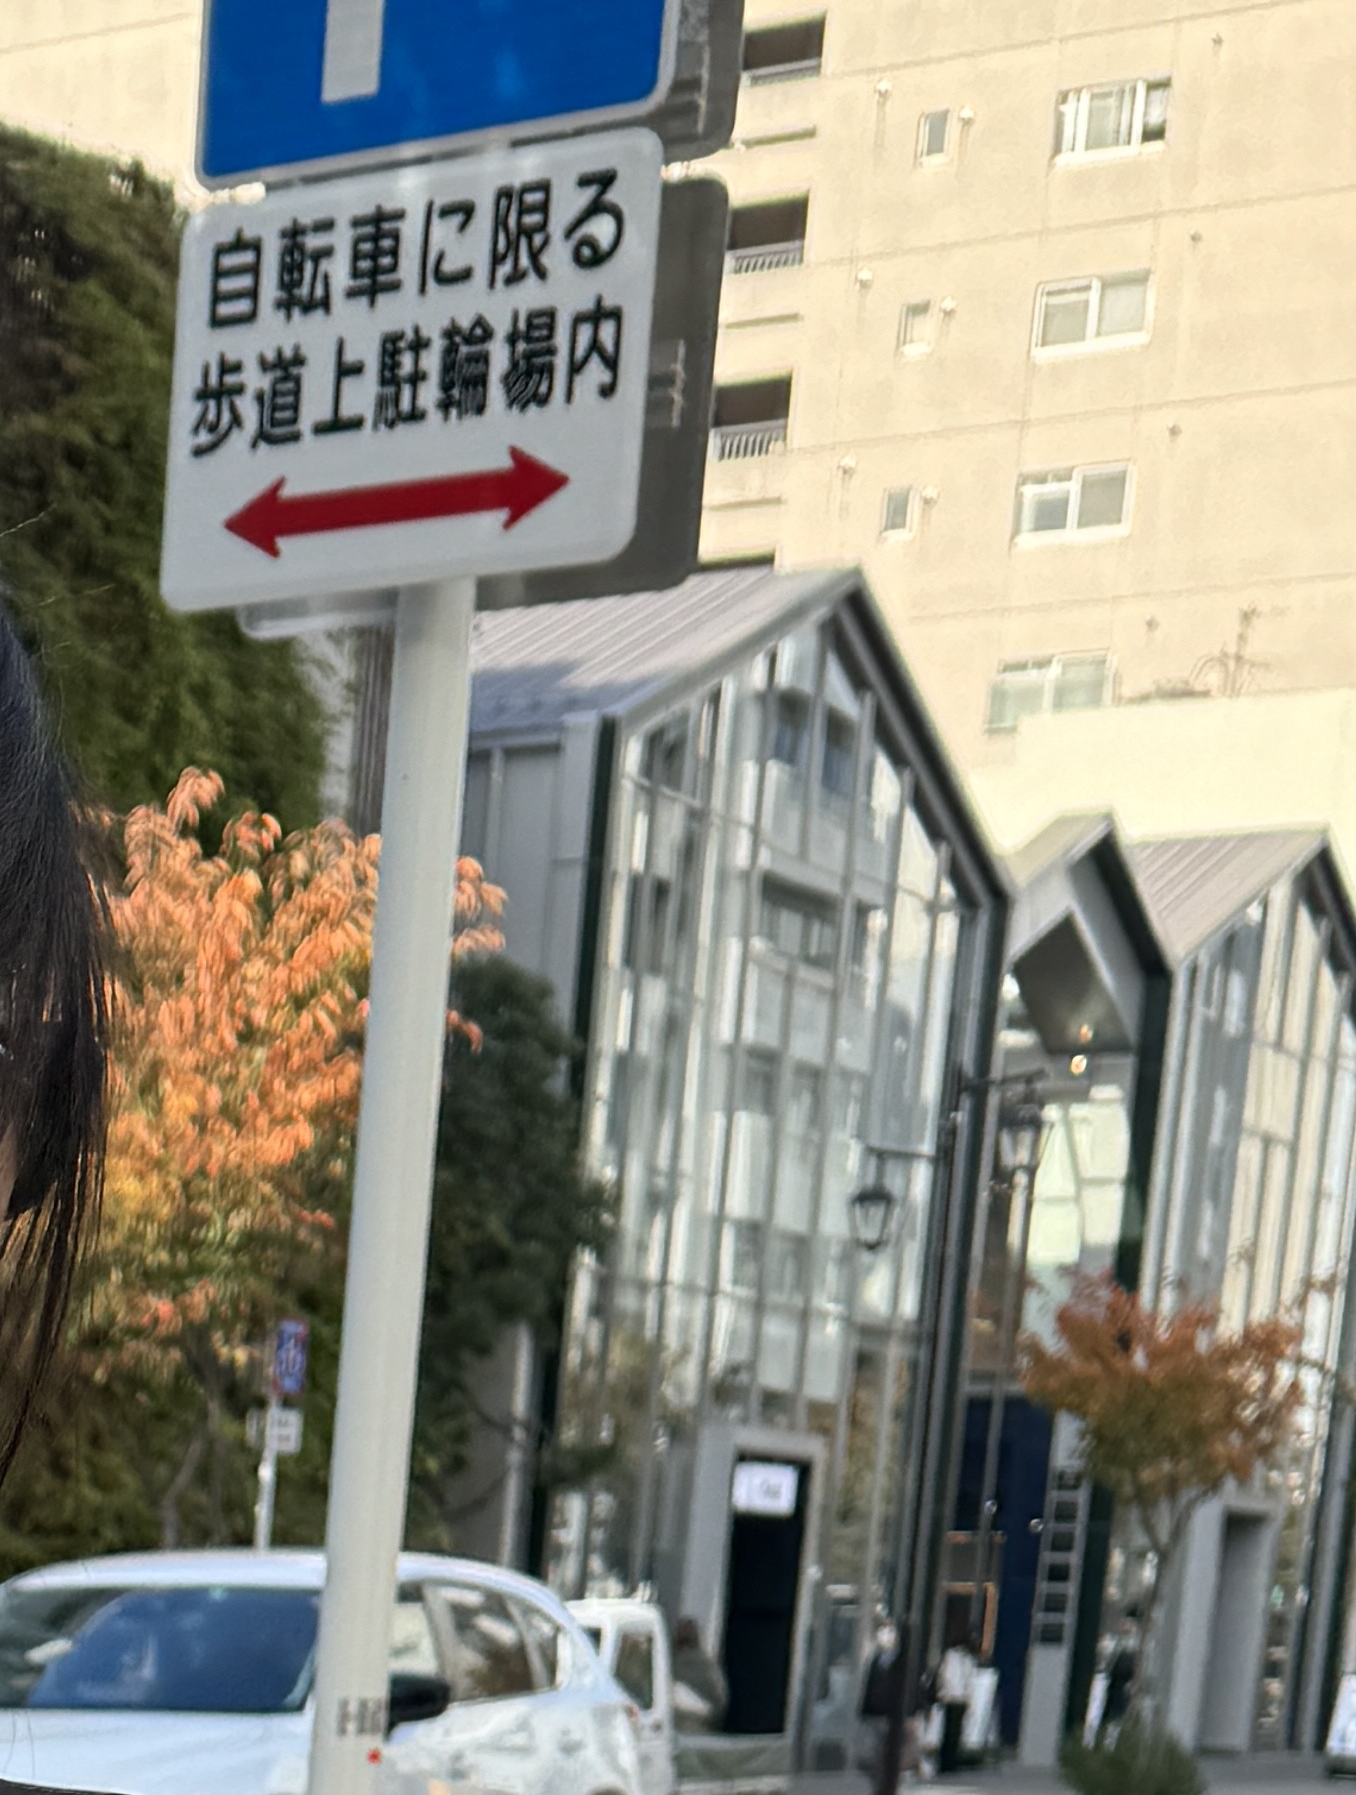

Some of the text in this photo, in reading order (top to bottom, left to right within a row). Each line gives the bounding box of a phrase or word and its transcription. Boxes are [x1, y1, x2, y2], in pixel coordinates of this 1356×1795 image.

[209, 168, 625, 329] 自転車に限る
[190, 295, 625, 459] 歩道上駐輪場内
